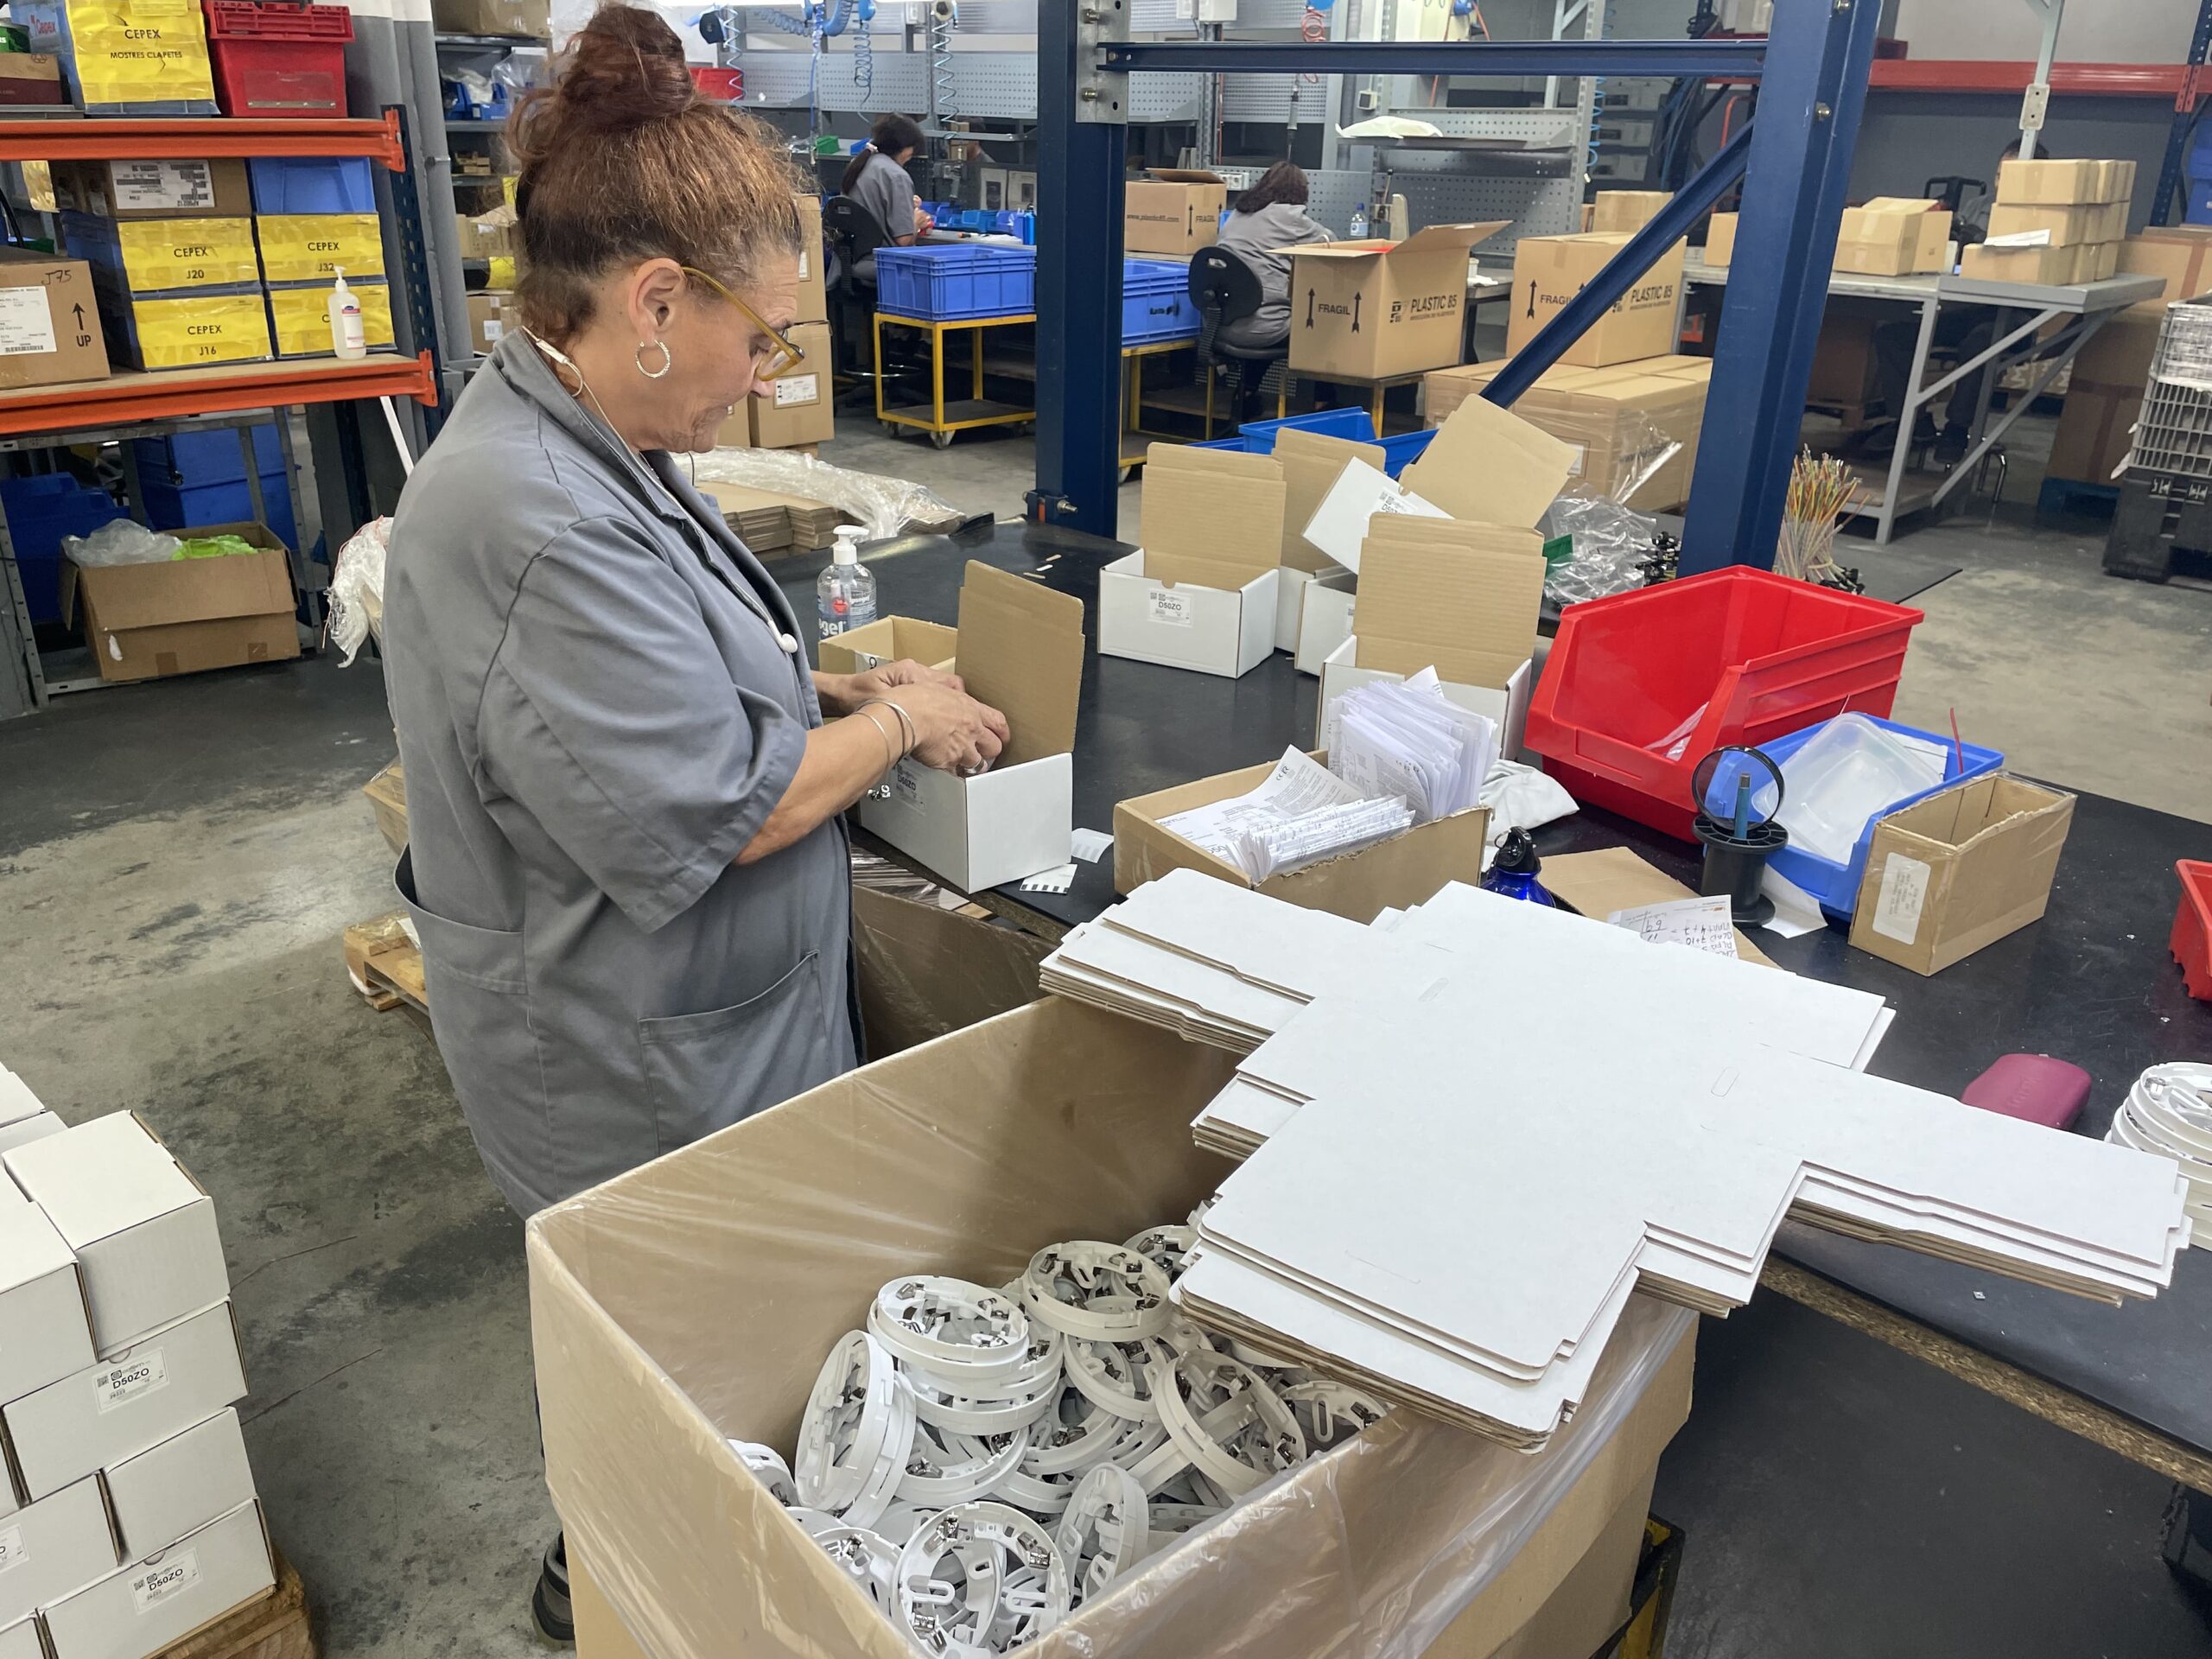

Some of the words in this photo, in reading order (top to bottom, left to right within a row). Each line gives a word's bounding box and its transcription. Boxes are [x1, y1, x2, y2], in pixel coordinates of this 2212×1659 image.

[124, 29, 162, 40] CEPEX
[174, 246, 208, 257] CEPEX
[308, 241, 340, 251] CEPEX
[318, 262, 334, 272] J32
[41, 269, 73, 285] J75
[186, 270, 205, 279] J20
[1630, 285, 1662, 303] PLASTIC
[1318, 303, 1351, 315] FRAGIL
[1410, 295, 1446, 314] PLASTIC
[187, 325, 222, 335] CEPEX
[76, 334, 92, 347] UP
[199, 346, 217, 356] J16
[1158, 601, 1182, 611] D50ZO
[112, 1368, 149, 1389] D50ZO
[149, 1568, 183, 1591] D50ZO
